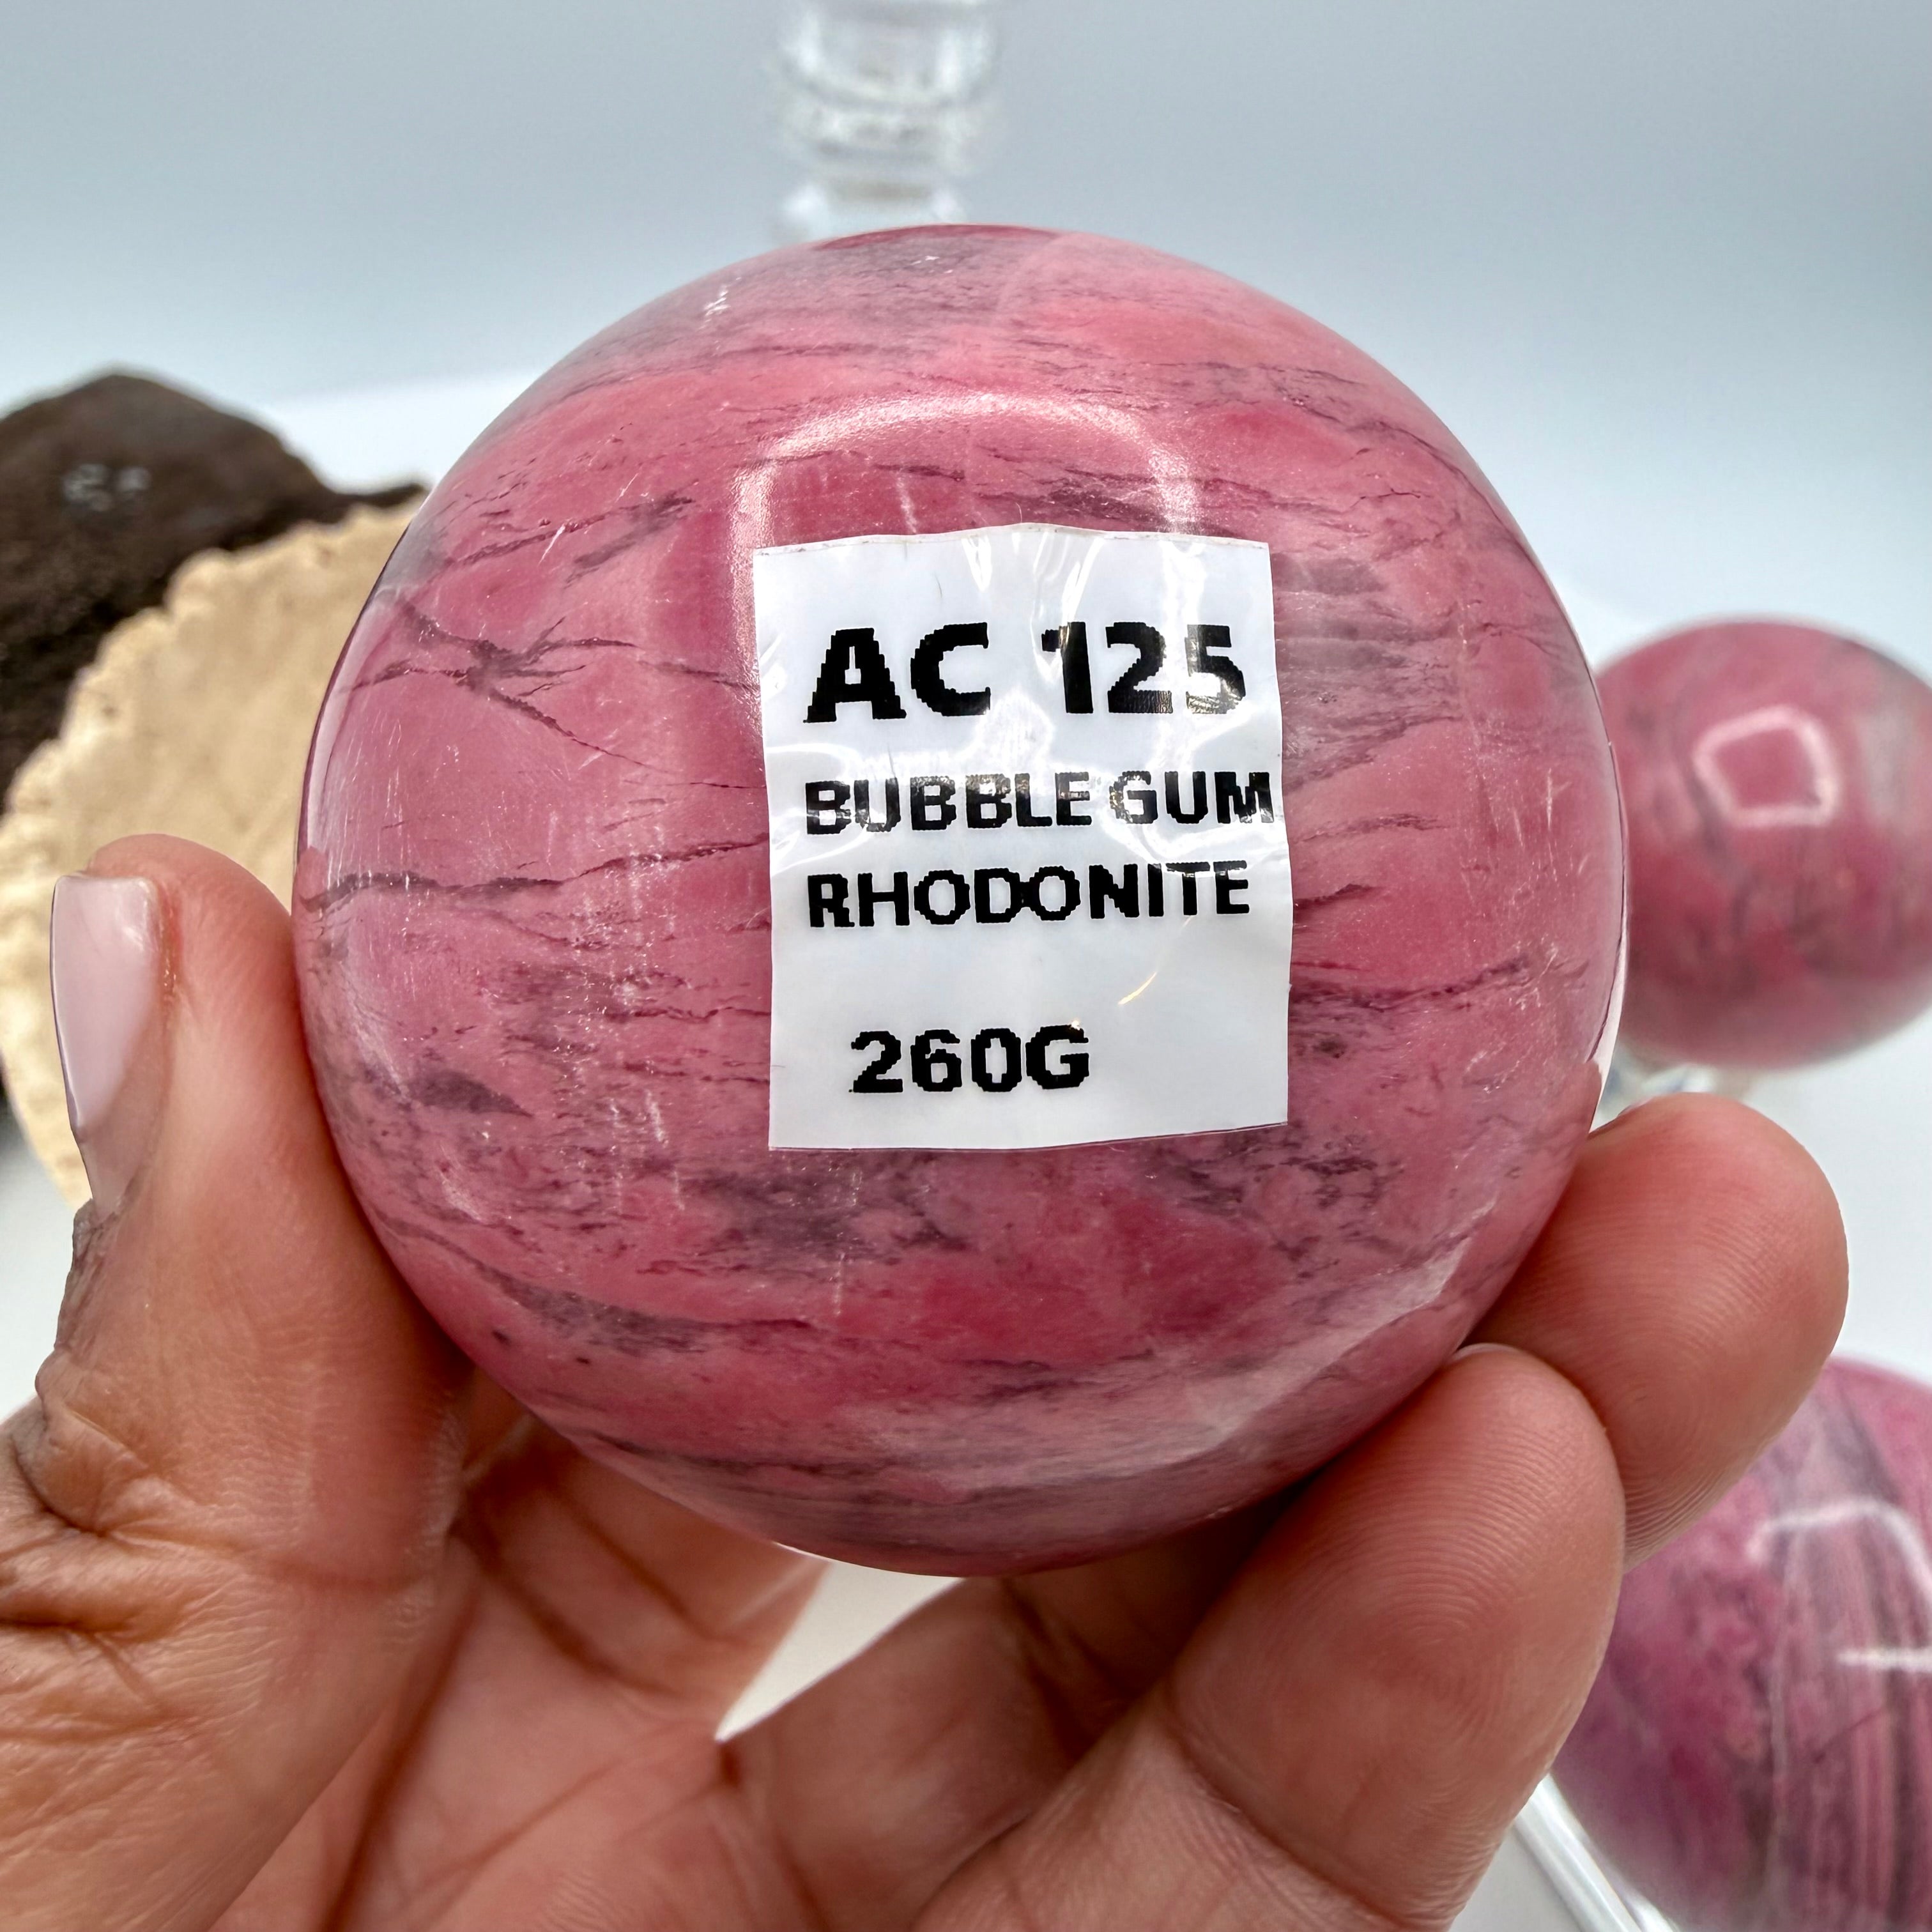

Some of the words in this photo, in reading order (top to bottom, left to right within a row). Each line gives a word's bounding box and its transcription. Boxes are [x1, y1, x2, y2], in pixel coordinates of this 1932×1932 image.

[803, 622, 992, 723] AC
[1041, 621, 1246, 715] 125
[804, 772, 1092, 835] BUBBLE
[1109, 770, 1275, 825] GUM
[806, 860, 1250, 928] RHODONITE
[850, 1024, 1090, 1094] 260G
